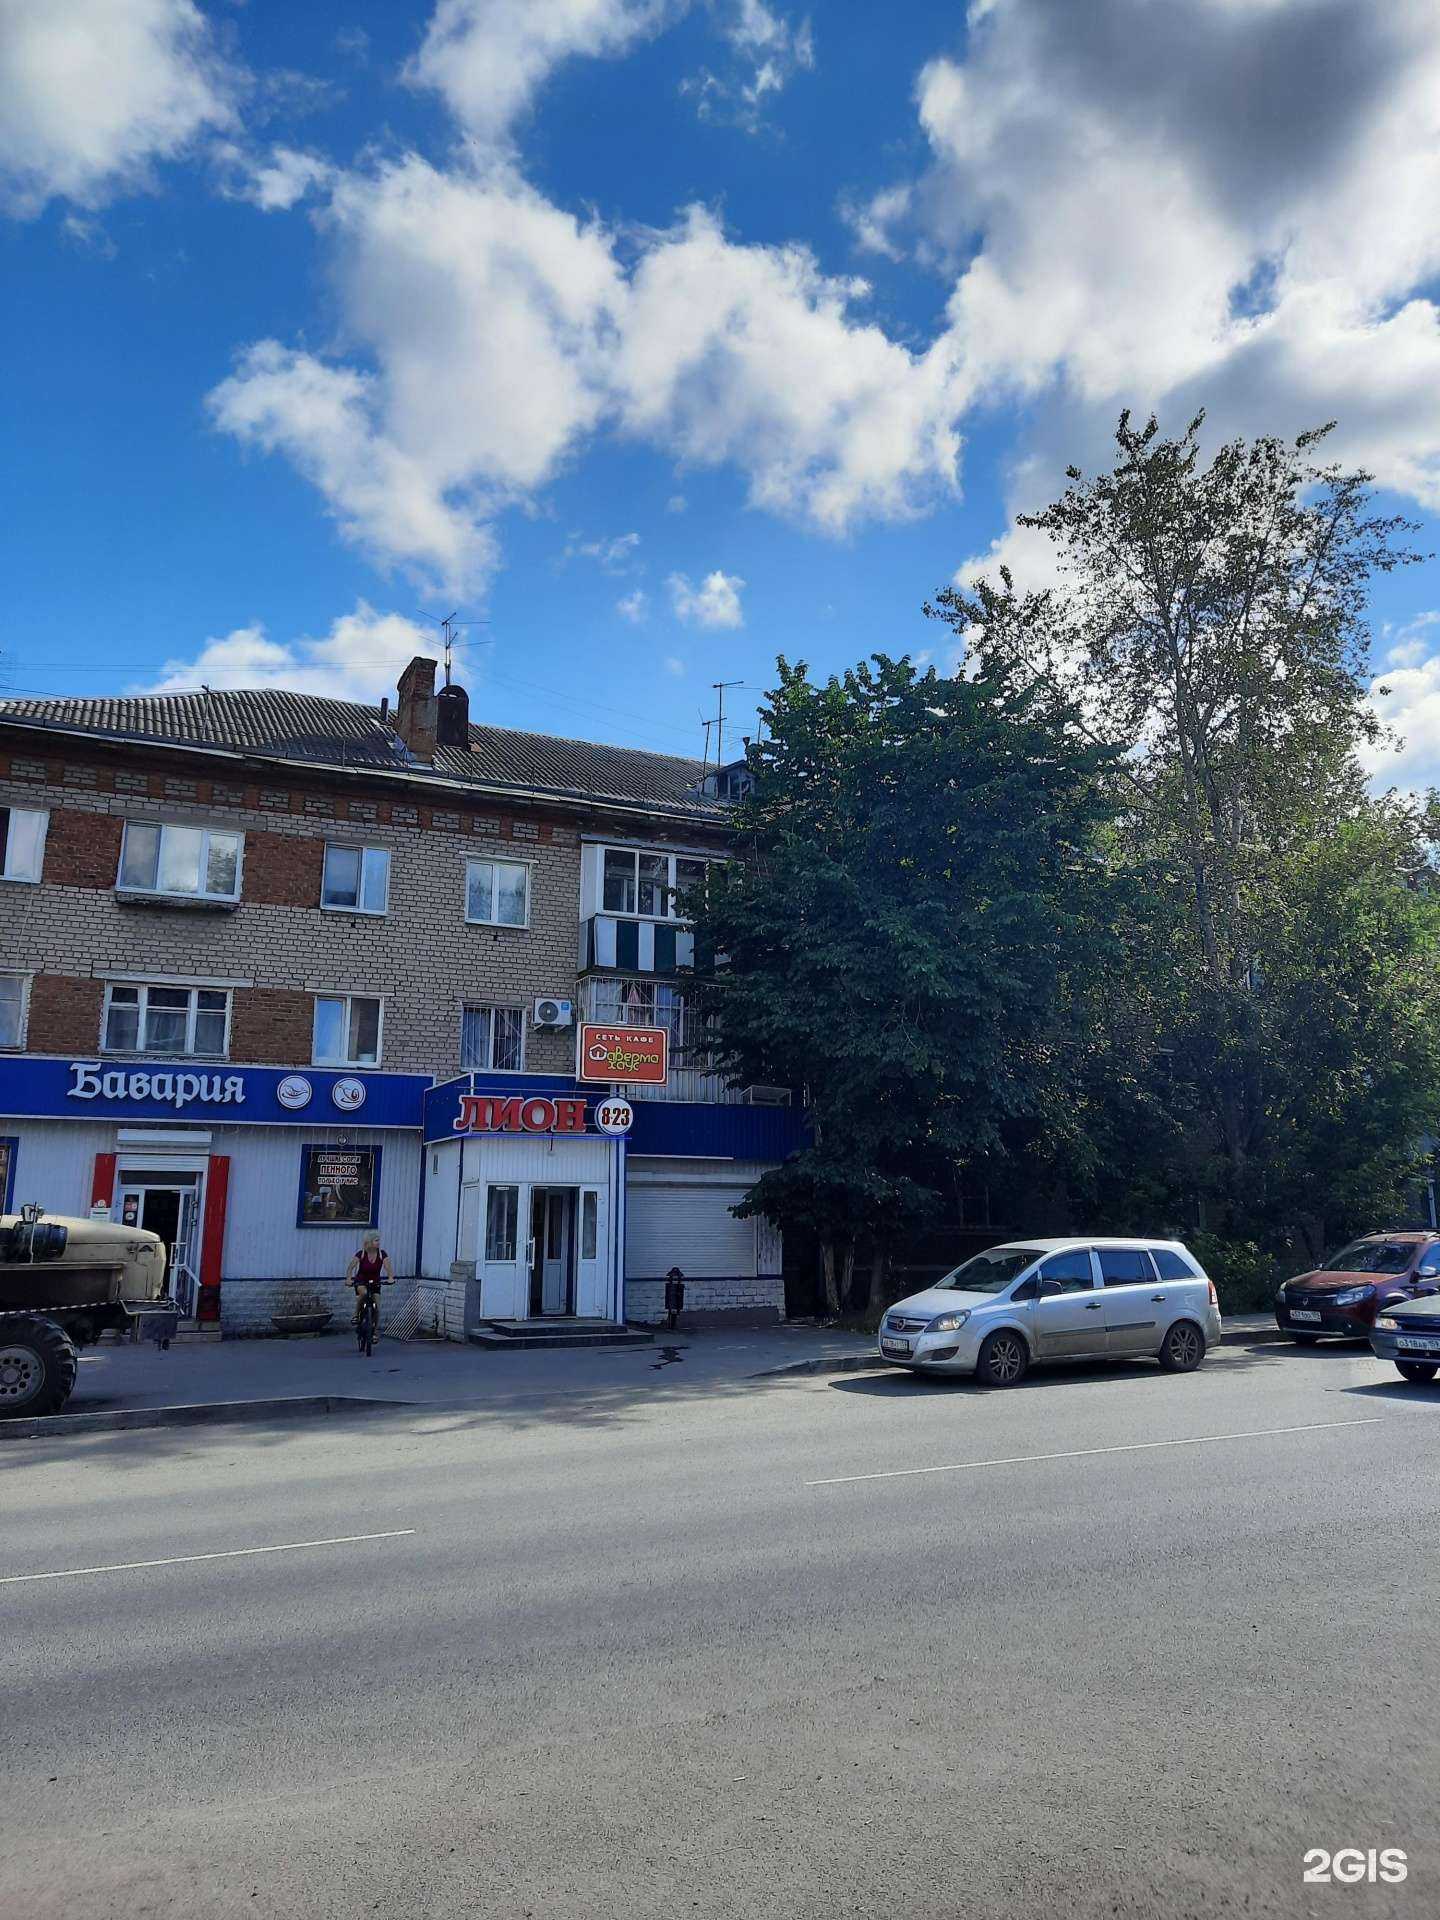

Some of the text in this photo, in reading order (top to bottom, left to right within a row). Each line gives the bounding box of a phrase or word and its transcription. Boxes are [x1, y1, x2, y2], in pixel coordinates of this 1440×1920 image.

[67, 1063, 246, 1108] Бавария
[453, 1095, 588, 1133] ЛИОН
[320, 1165, 357, 1175] ПЕННОГО
